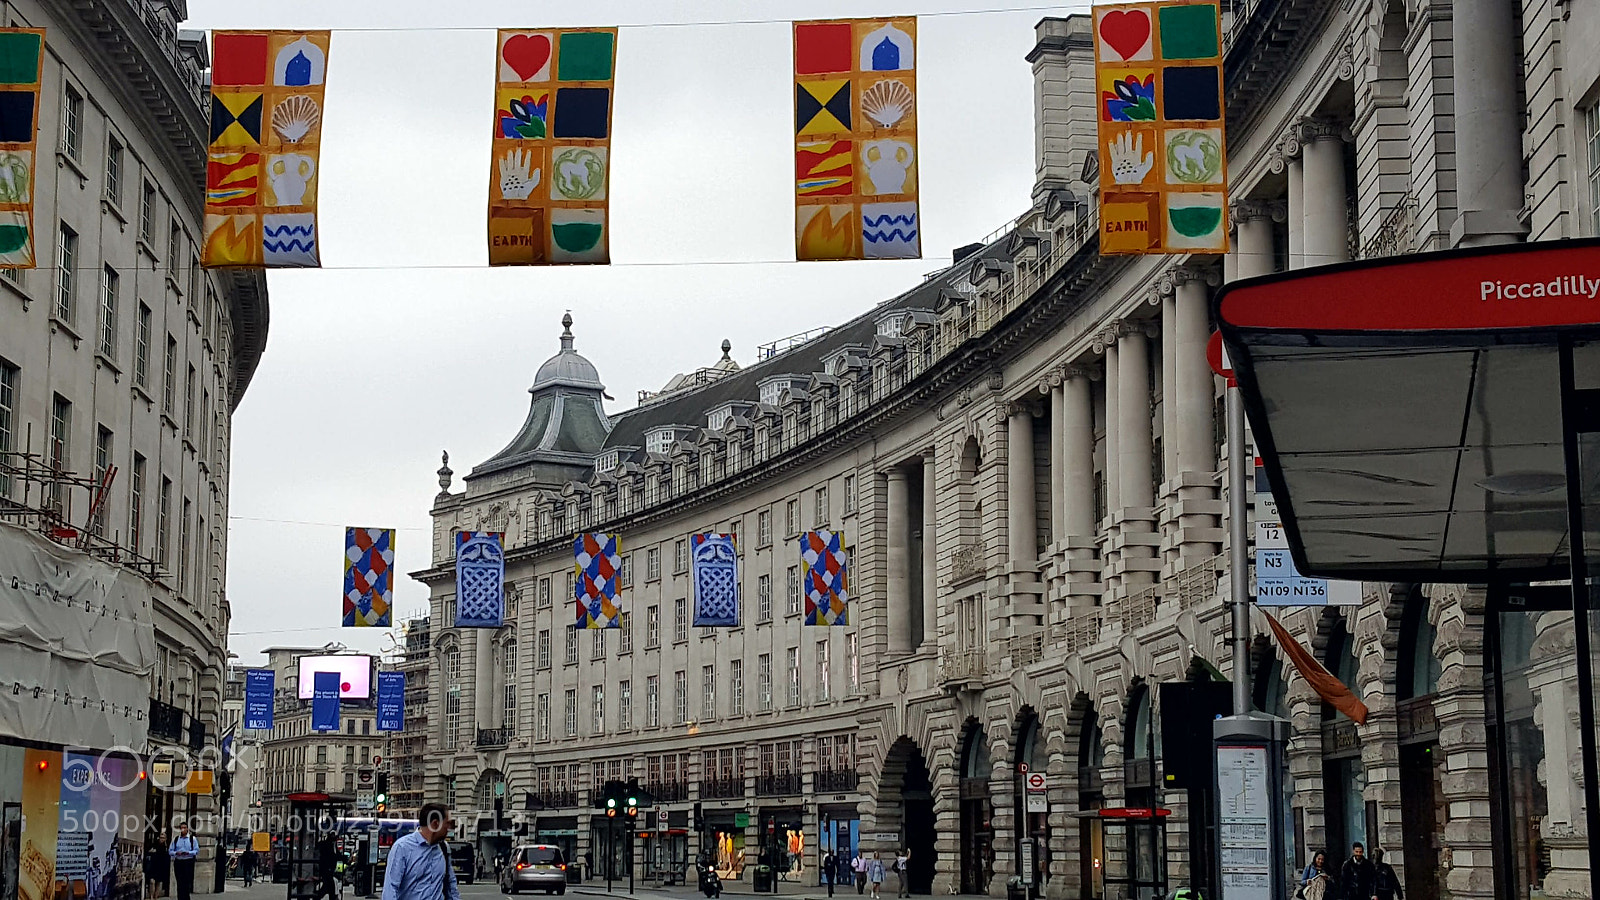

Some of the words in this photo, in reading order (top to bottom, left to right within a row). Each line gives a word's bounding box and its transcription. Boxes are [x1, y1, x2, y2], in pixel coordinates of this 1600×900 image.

[1105, 220, 1147, 232] EARTH
[493, 235, 532, 246] EARTH
[1480, 275, 1600, 301] Piccadilly
[1266, 529, 1279, 540] 12
[1264, 558, 1282, 568] N3
[1259, 586, 1290, 596] N109
[1293, 586, 1325, 596] N136
[249, 719, 267, 728] RA250
[1021, 763, 1028, 771] D
